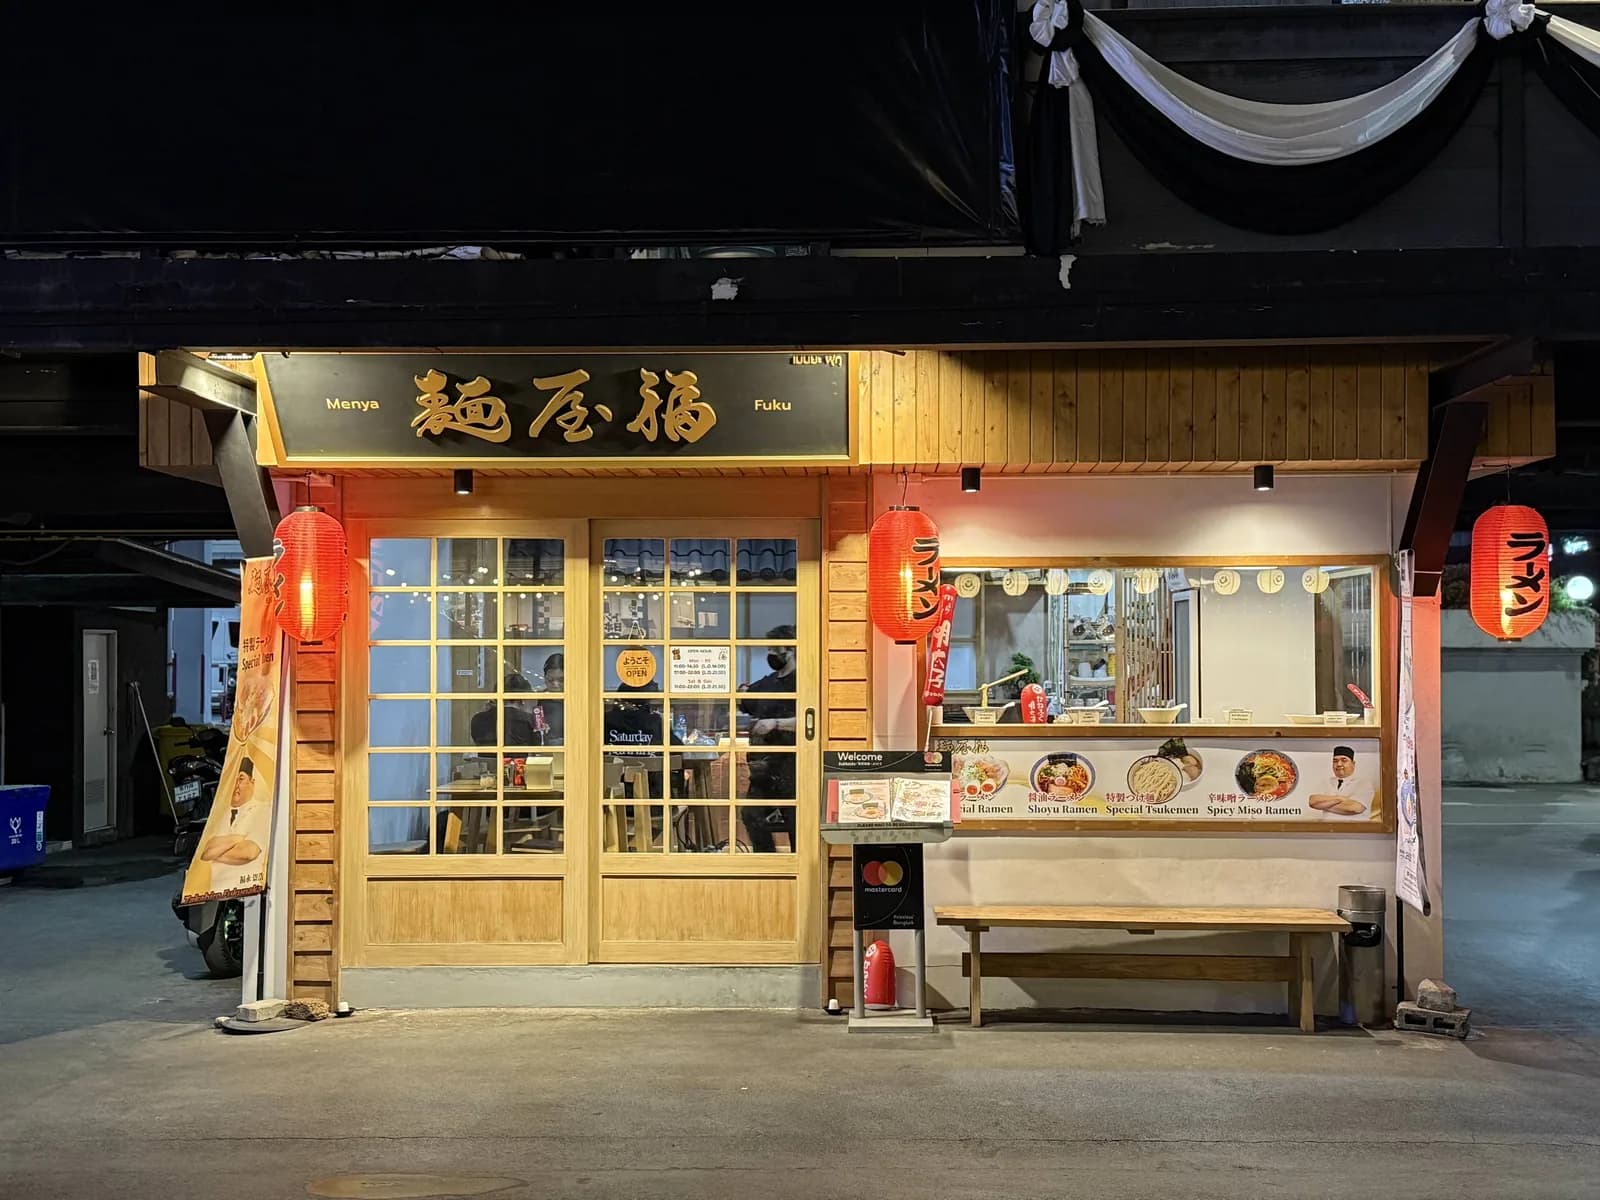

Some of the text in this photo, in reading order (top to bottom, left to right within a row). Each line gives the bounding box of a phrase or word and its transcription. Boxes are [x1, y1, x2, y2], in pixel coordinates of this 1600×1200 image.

[326, 397, 380, 411] Menya
[754, 398, 792, 411] Fuku
[913, 537, 940, 620] ラーメン
[1505, 532, 1546, 617] ラーメン
[623, 656, 650, 666] ようこそ
[626, 668, 648, 677] OPEN
[609, 729, 653, 744] Saturday
[837, 751, 883, 761] Welcome
[978, 804, 1013, 813] Ramen
[1028, 804, 1098, 816] Shoyu Ramen
[1105, 804, 1199, 816] Special Tsukemen
[1207, 805, 1302, 816] Spicy Miso Ramen
